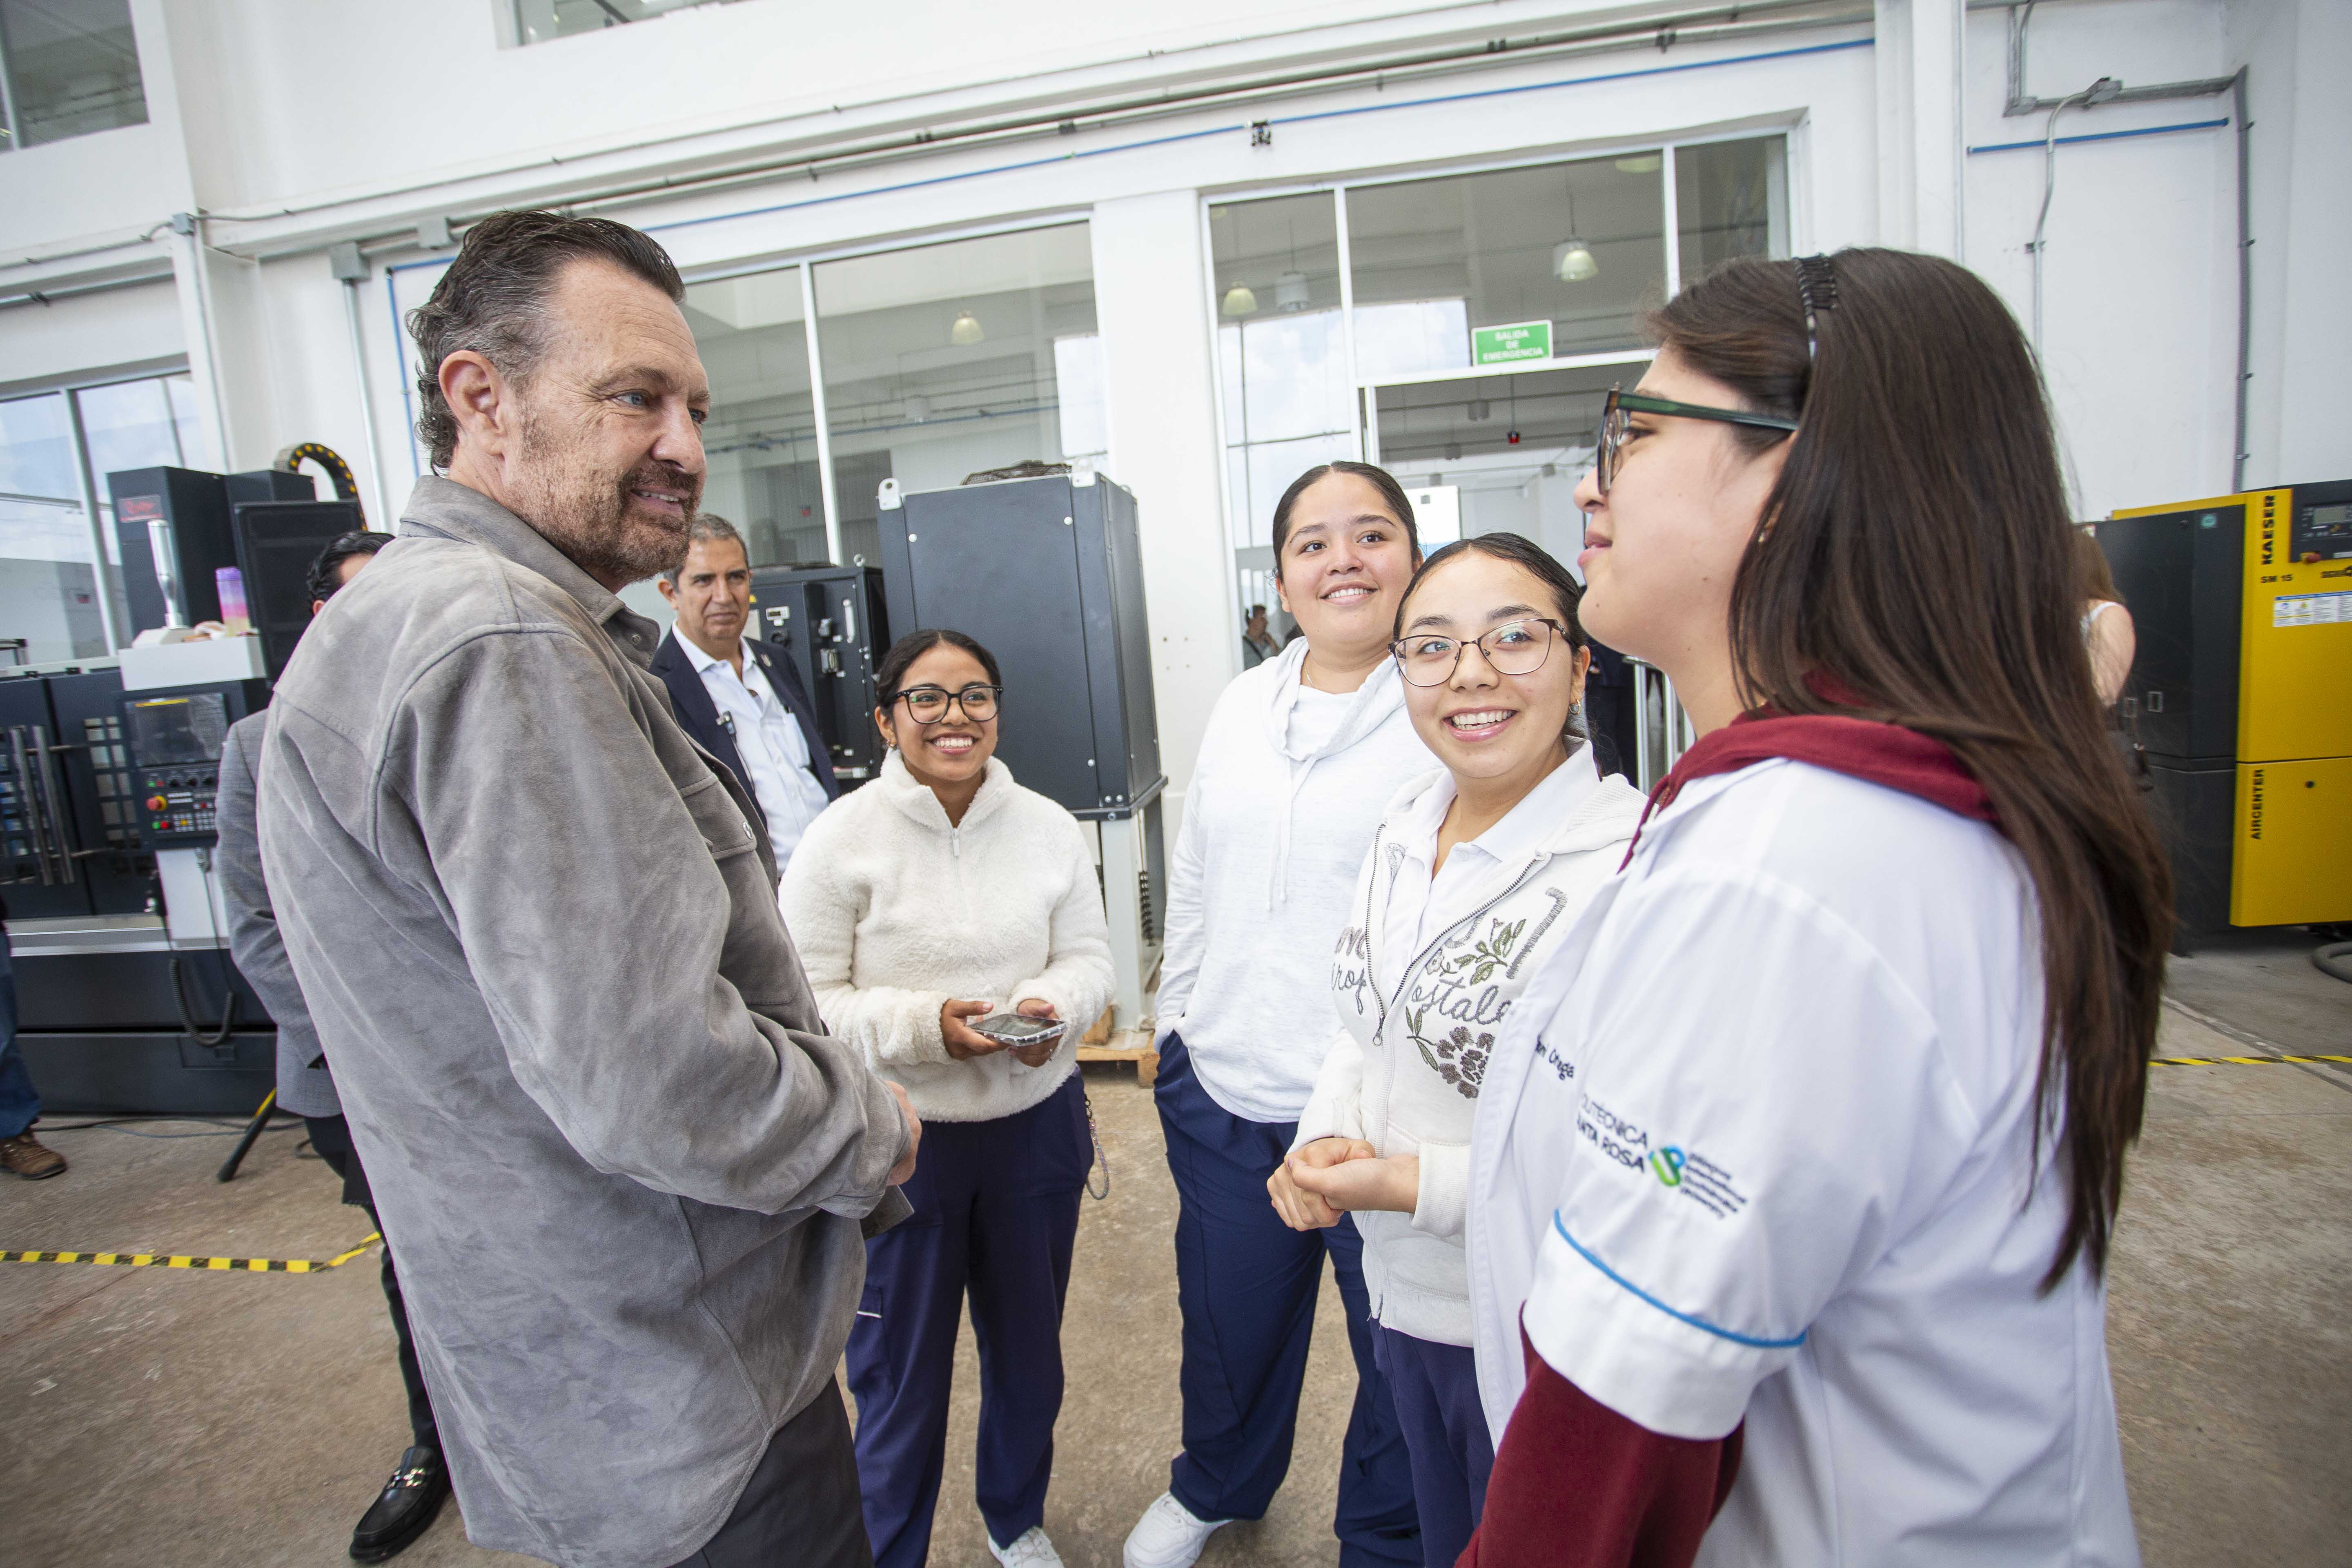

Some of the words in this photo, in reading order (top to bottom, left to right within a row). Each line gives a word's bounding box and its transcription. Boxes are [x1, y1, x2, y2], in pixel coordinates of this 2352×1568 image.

[1495, 329, 1530, 342] SALIDA
[1505, 339, 1519, 350] DE
[1482, 346, 1544, 362] EMERGENCIA
[2261, 495, 2275, 565] KAESER
[2250, 768, 2265, 840] AIRCENTER
[1601, 1136, 1645, 1174] ROSA
